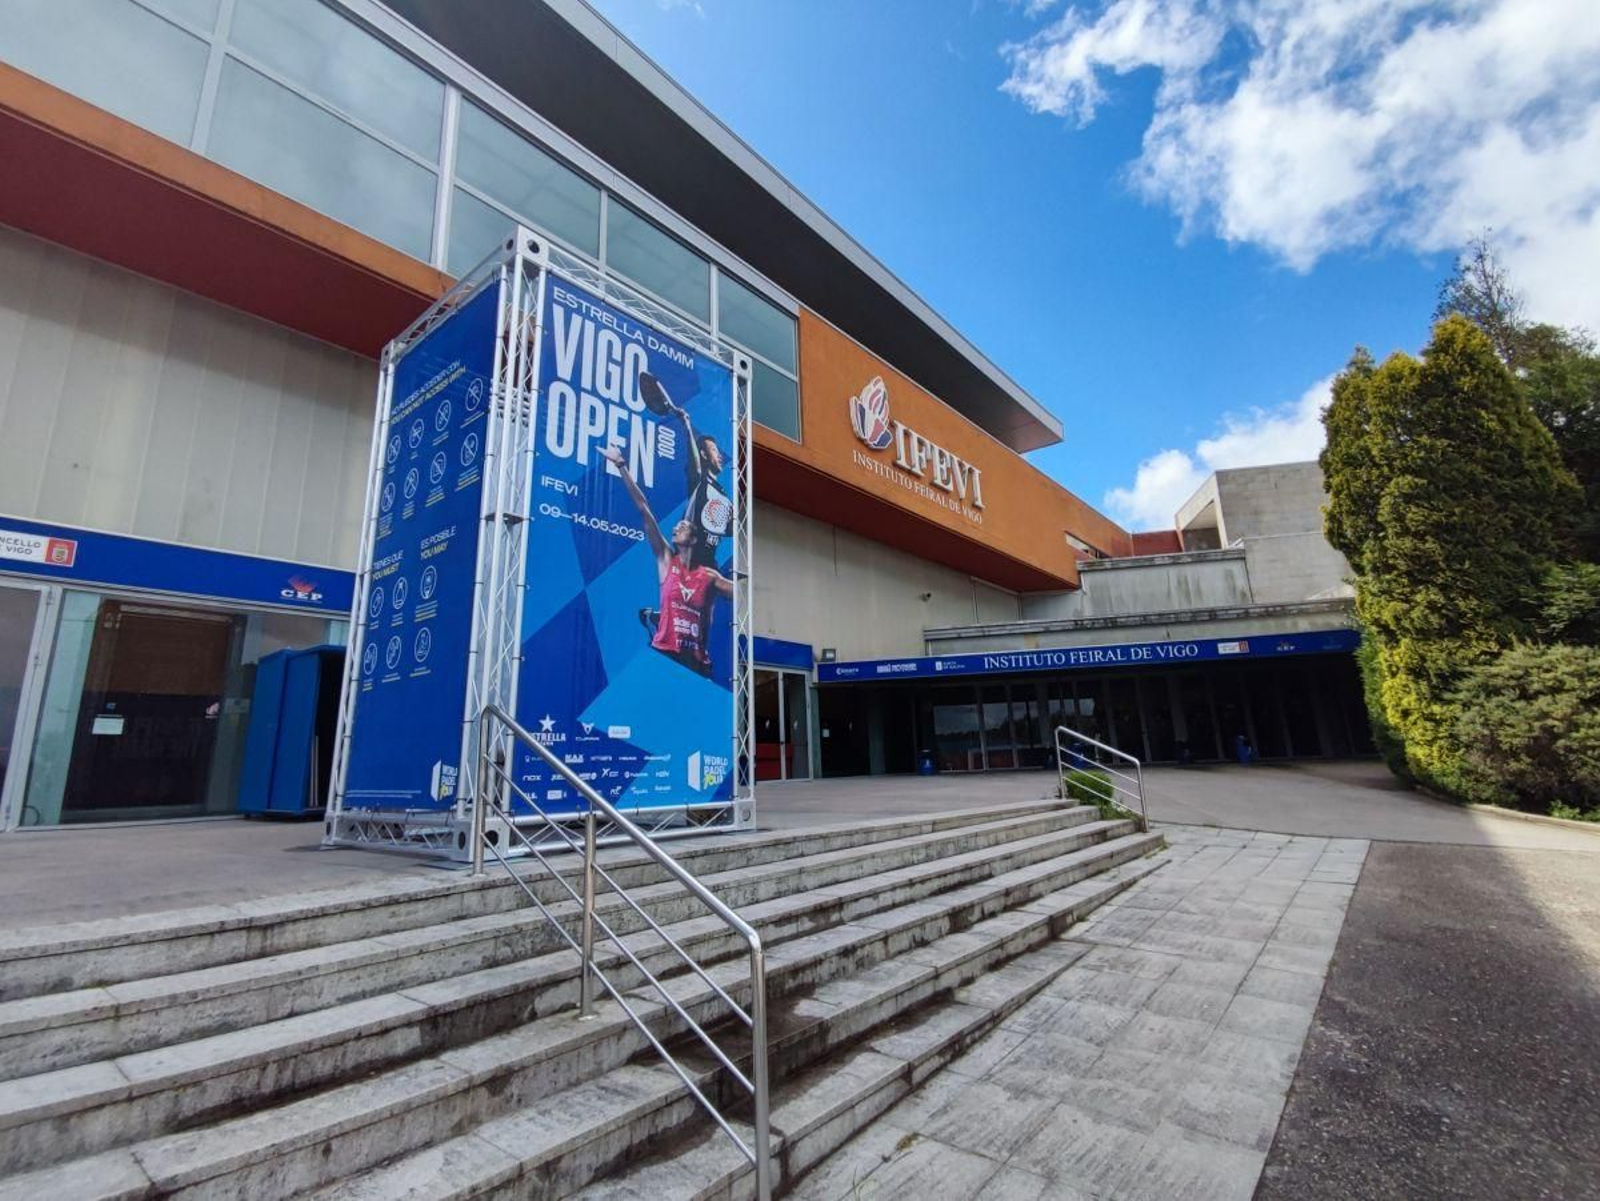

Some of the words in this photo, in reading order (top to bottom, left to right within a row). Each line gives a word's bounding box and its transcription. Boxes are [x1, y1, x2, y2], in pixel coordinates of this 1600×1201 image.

[553, 285, 644, 345] ESTRELLA
[647, 335, 694, 370] DAMM
[552, 303, 649, 413] VIGO
[545, 380, 656, 489] OPEN
[658, 424, 676, 461] 1000
[892, 419, 985, 509] IFEVI
[541, 475, 578, 497] IFEVI
[852, 449, 913, 490] INSTITUTO
[914, 481, 949, 508] FEIRAL
[948, 498, 961, 514] DE
[961, 505, 982, 524] VIGO
[6, 545, 33, 555] VIGO
[280, 589, 323, 601] CEP
[983, 651, 1066, 669] INSTITUTO
[1070, 648, 1127, 664] FEIRAL
[1131, 646, 1153, 660] DE
[1155, 644, 1199, 658] VIGO
[703, 755, 729, 766] WORLD
[703, 765, 727, 777] PADEL
[703, 773, 724, 790] TOUR
